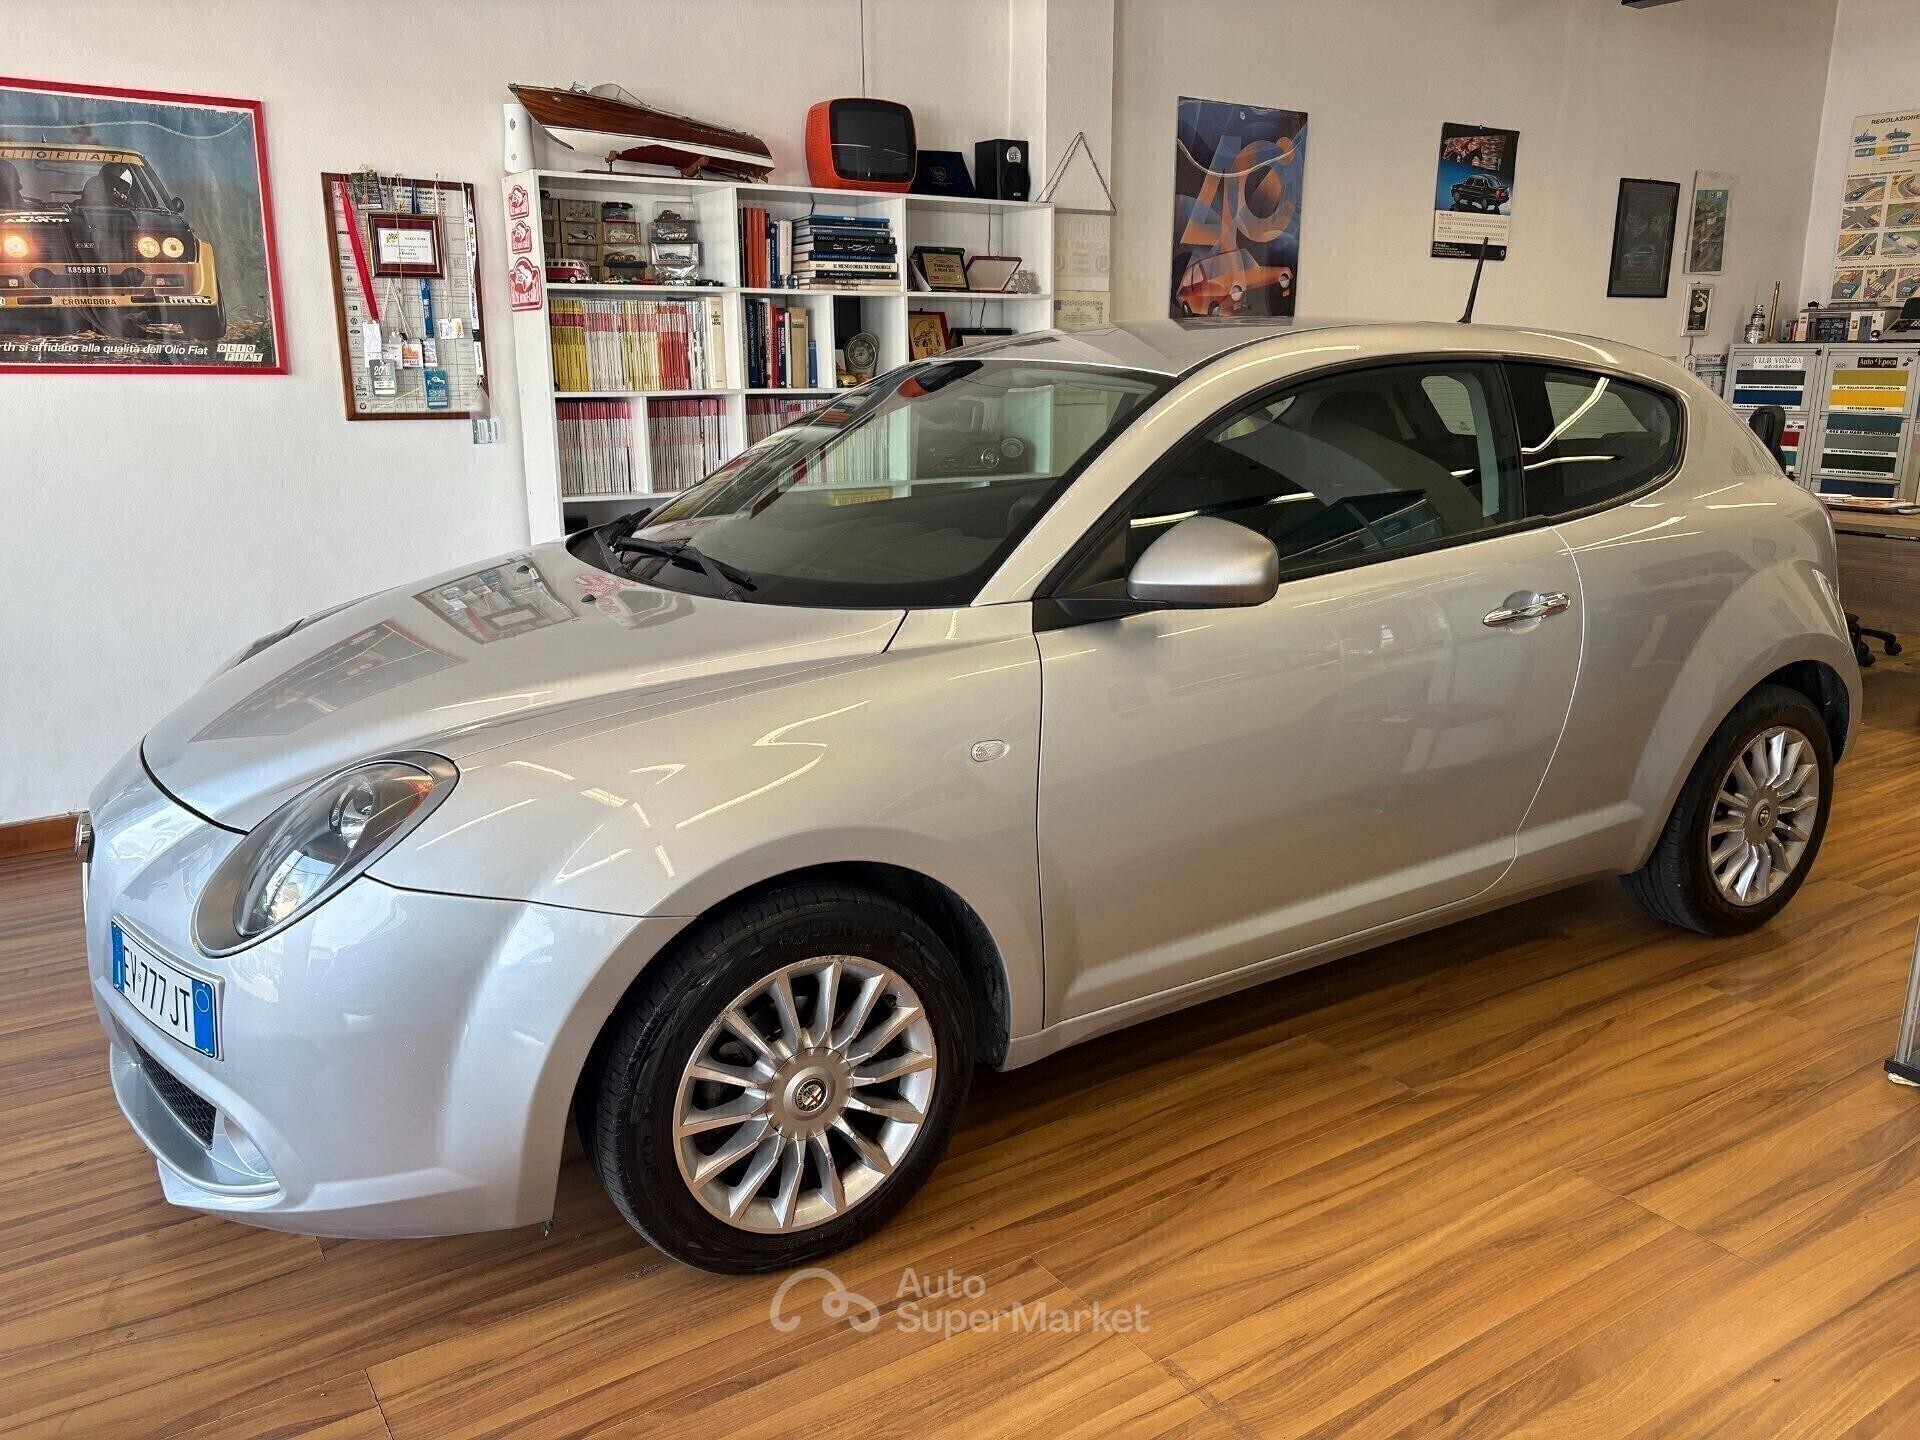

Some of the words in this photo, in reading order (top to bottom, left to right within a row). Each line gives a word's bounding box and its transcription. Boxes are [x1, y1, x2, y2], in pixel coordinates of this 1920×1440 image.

[18, 342, 29, 352] si
[31, 341, 79, 353] affidano
[81, 343, 101, 353] alla
[103, 344, 140, 354] qualità
[143, 344, 186, 354] dell'Olio
[188, 345, 209, 355] Fiat
[218, 344, 256, 352] OLIO
[226, 353, 263, 361] FIAT
[1754, 356, 1773, 364] CLUB
[1775, 357, 1803, 365] VENEZIA
[1858, 357, 1874, 366] Auto
[140, 961, 166, 1016] 777
[169, 985, 190, 1033] JT
